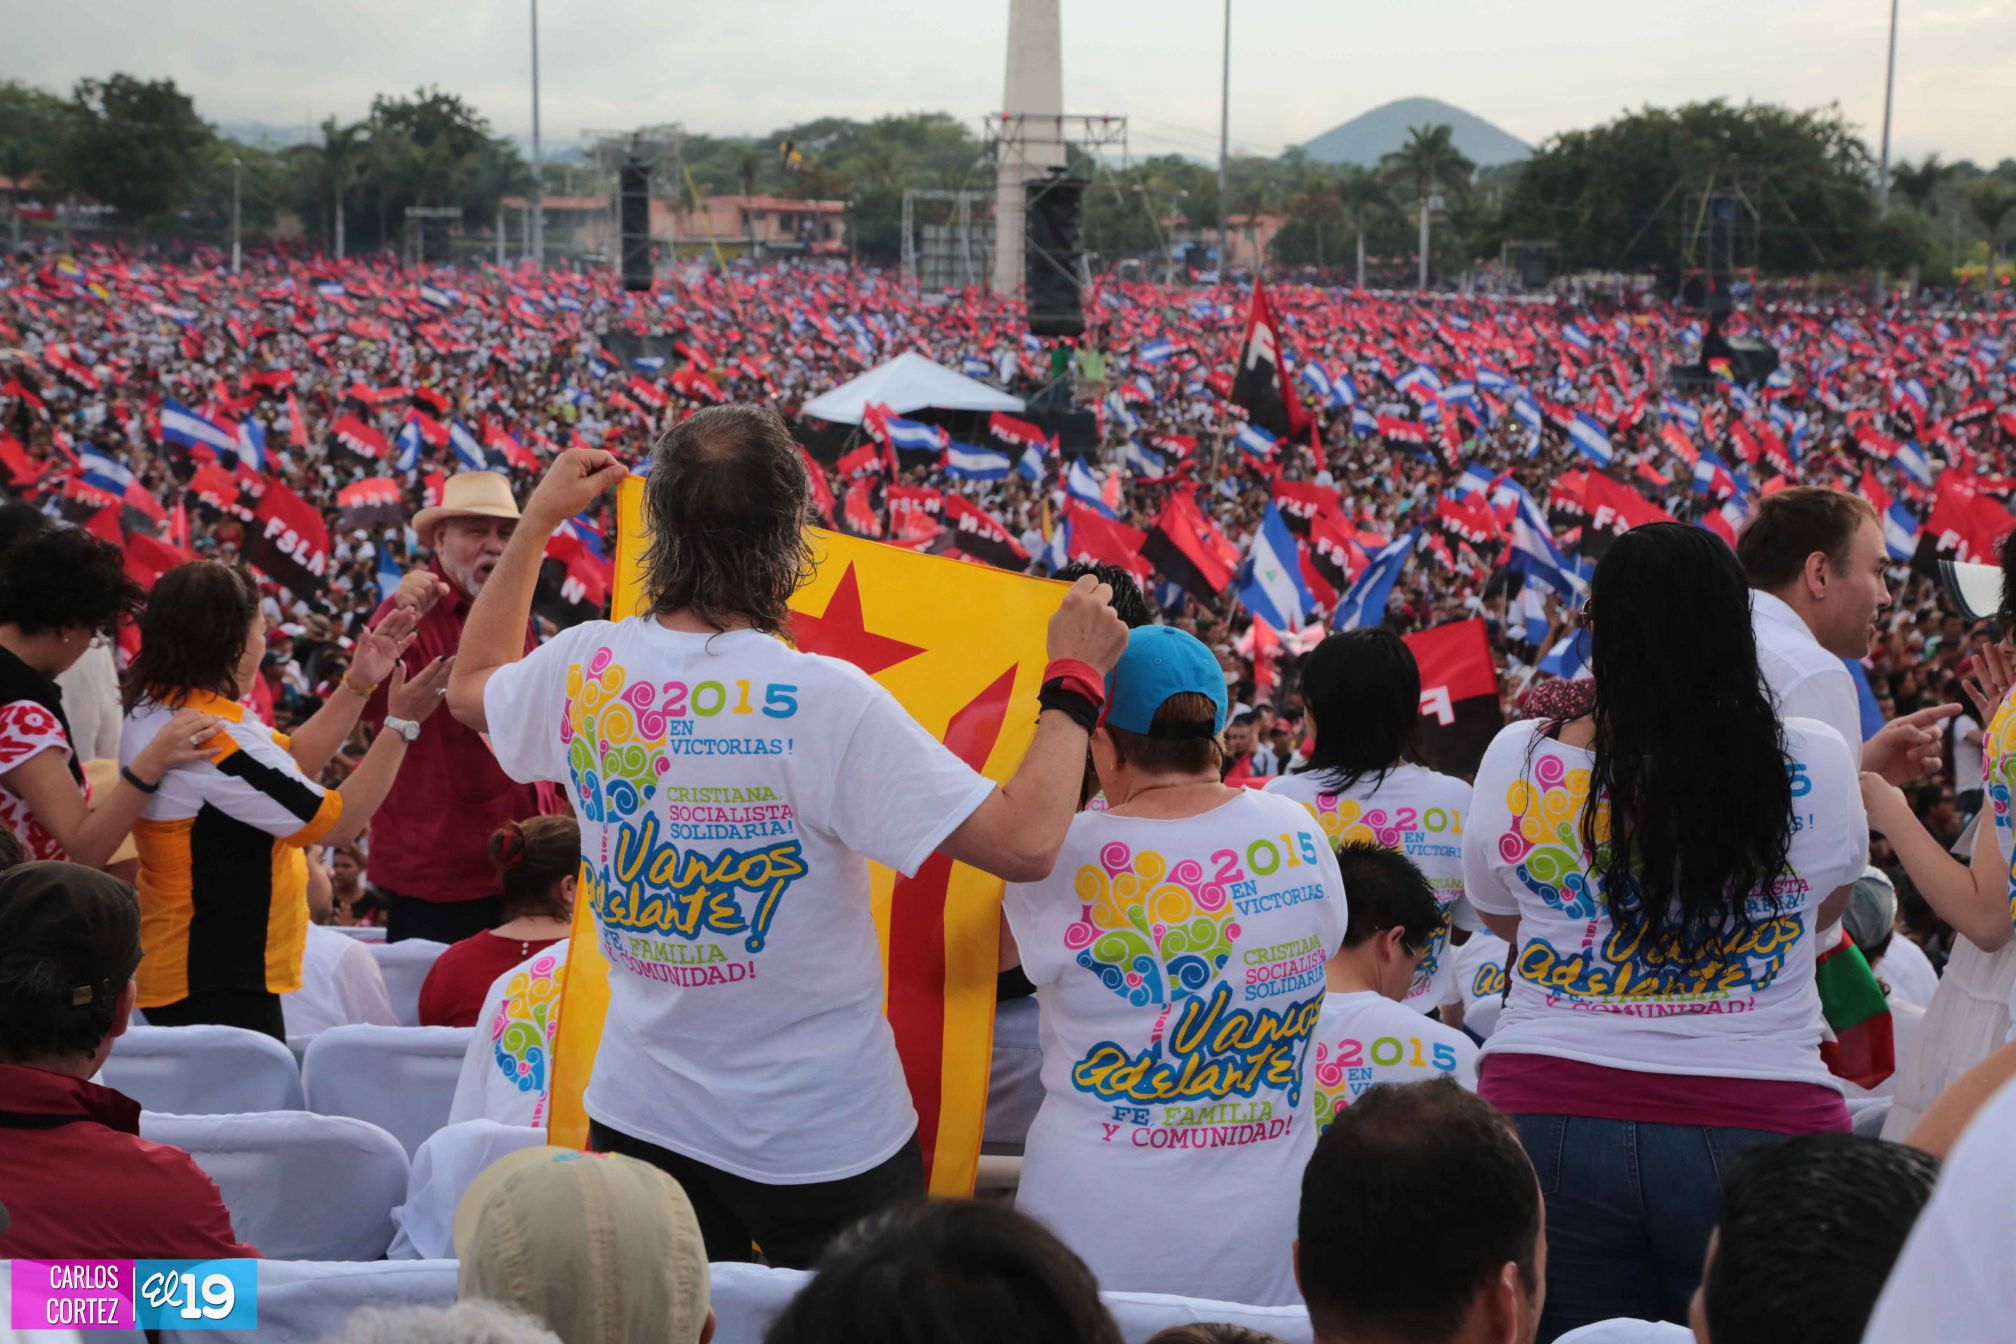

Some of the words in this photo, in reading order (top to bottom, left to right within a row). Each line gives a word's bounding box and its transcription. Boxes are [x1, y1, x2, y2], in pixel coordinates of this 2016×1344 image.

[263, 516, 326, 577] FSLN
[662, 679, 799, 718] 2015
[670, 720, 694, 736] EN
[670, 820, 794, 840] SOLIDARIA!
[1395, 807, 1464, 834] 201
[1404, 832, 1425, 843] EN
[1210, 831, 1318, 885] 2015
[1230, 880, 1258, 900] EN
[628, 936, 728, 965] FAMILIA
[620, 951, 756, 988] COMUNIDAD!
[1336, 1036, 1457, 1072] 2015
[1348, 1067, 1373, 1081] EN
[1160, 1101, 1274, 1126] FAMILIA
[1102, 1122, 1120, 1142] Y
[1132, 1115, 1293, 1149] COMUNIDAD!
